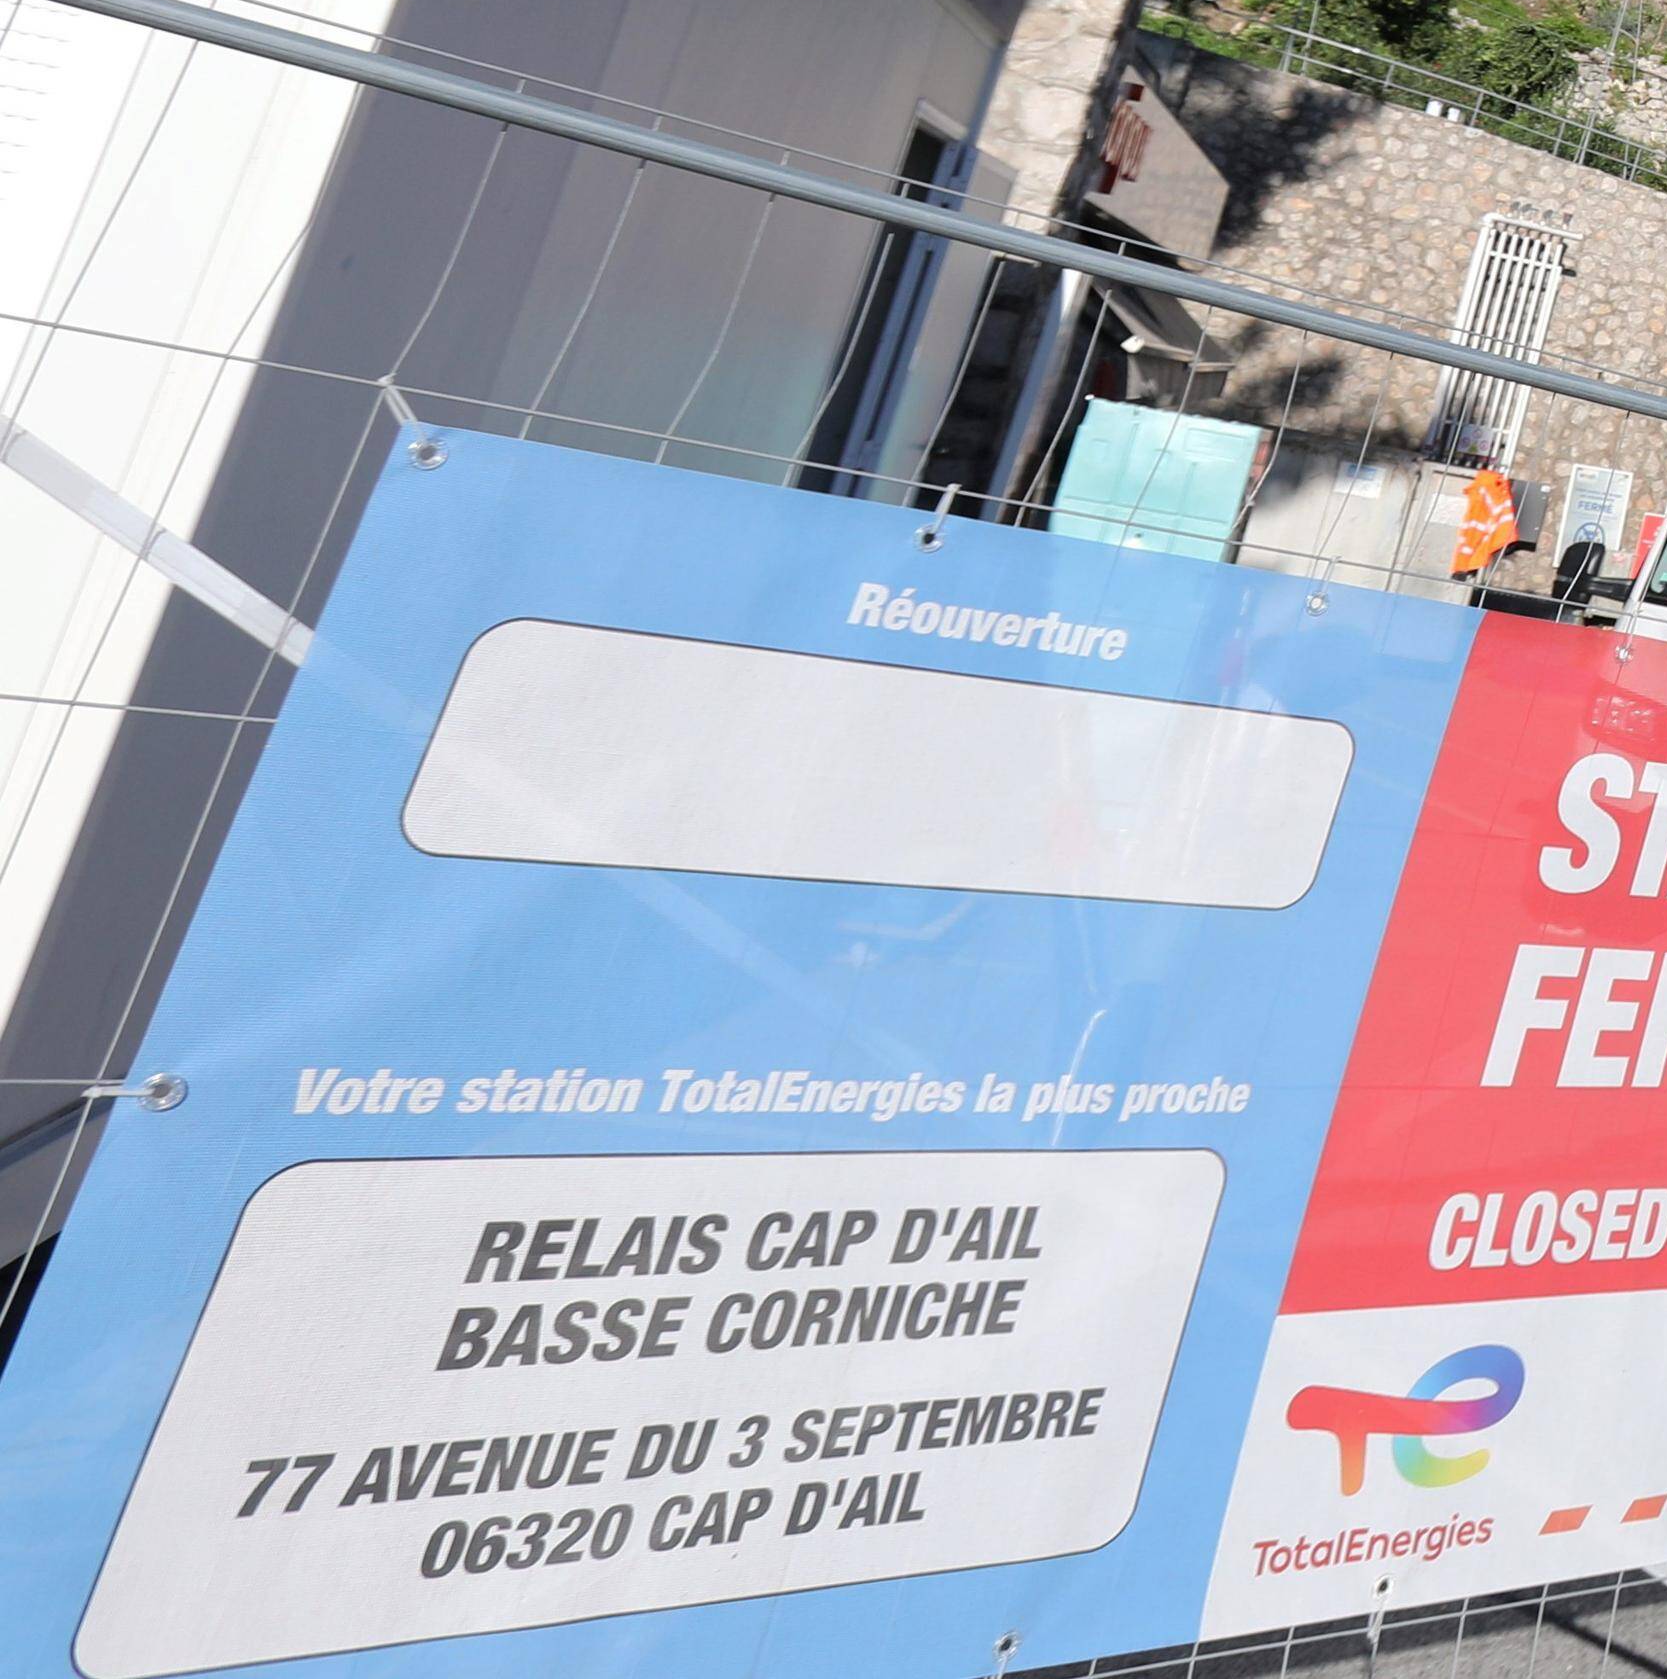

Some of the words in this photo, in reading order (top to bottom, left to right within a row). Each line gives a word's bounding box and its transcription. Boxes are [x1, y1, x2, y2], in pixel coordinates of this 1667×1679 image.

[846, 582, 1128, 661] Réouverture
[293, 1067, 445, 1115] Votre
[456, 1067, 645, 1114] station
[657, 1068, 966, 1123] TotalEnergies
[972, 1072, 1018, 1114] la
[1020, 1073, 1115, 1123] plus
[1117, 1076, 1251, 1123] proche
[464, 1212, 729, 1284] RELAIS
[746, 1208, 878, 1272] CAP
[890, 1205, 1042, 1265] D'AIL
[435, 1295, 694, 1372] BASSE
[706, 1279, 1028, 1354] CORNICHE
[236, 1452, 337, 1519] 77
[338, 1428, 619, 1508] AVENUE
[626, 1418, 720, 1480] DU
[728, 1414, 771, 1469] 3
[783, 1387, 1106, 1464] SEPTEMBRE
[420, 1503, 634, 1580] 06320
[648, 1488, 773, 1553] CAP
[783, 1471, 925, 1537] D'AIL
[1252, 1512, 1496, 1578] TotalEnergies
